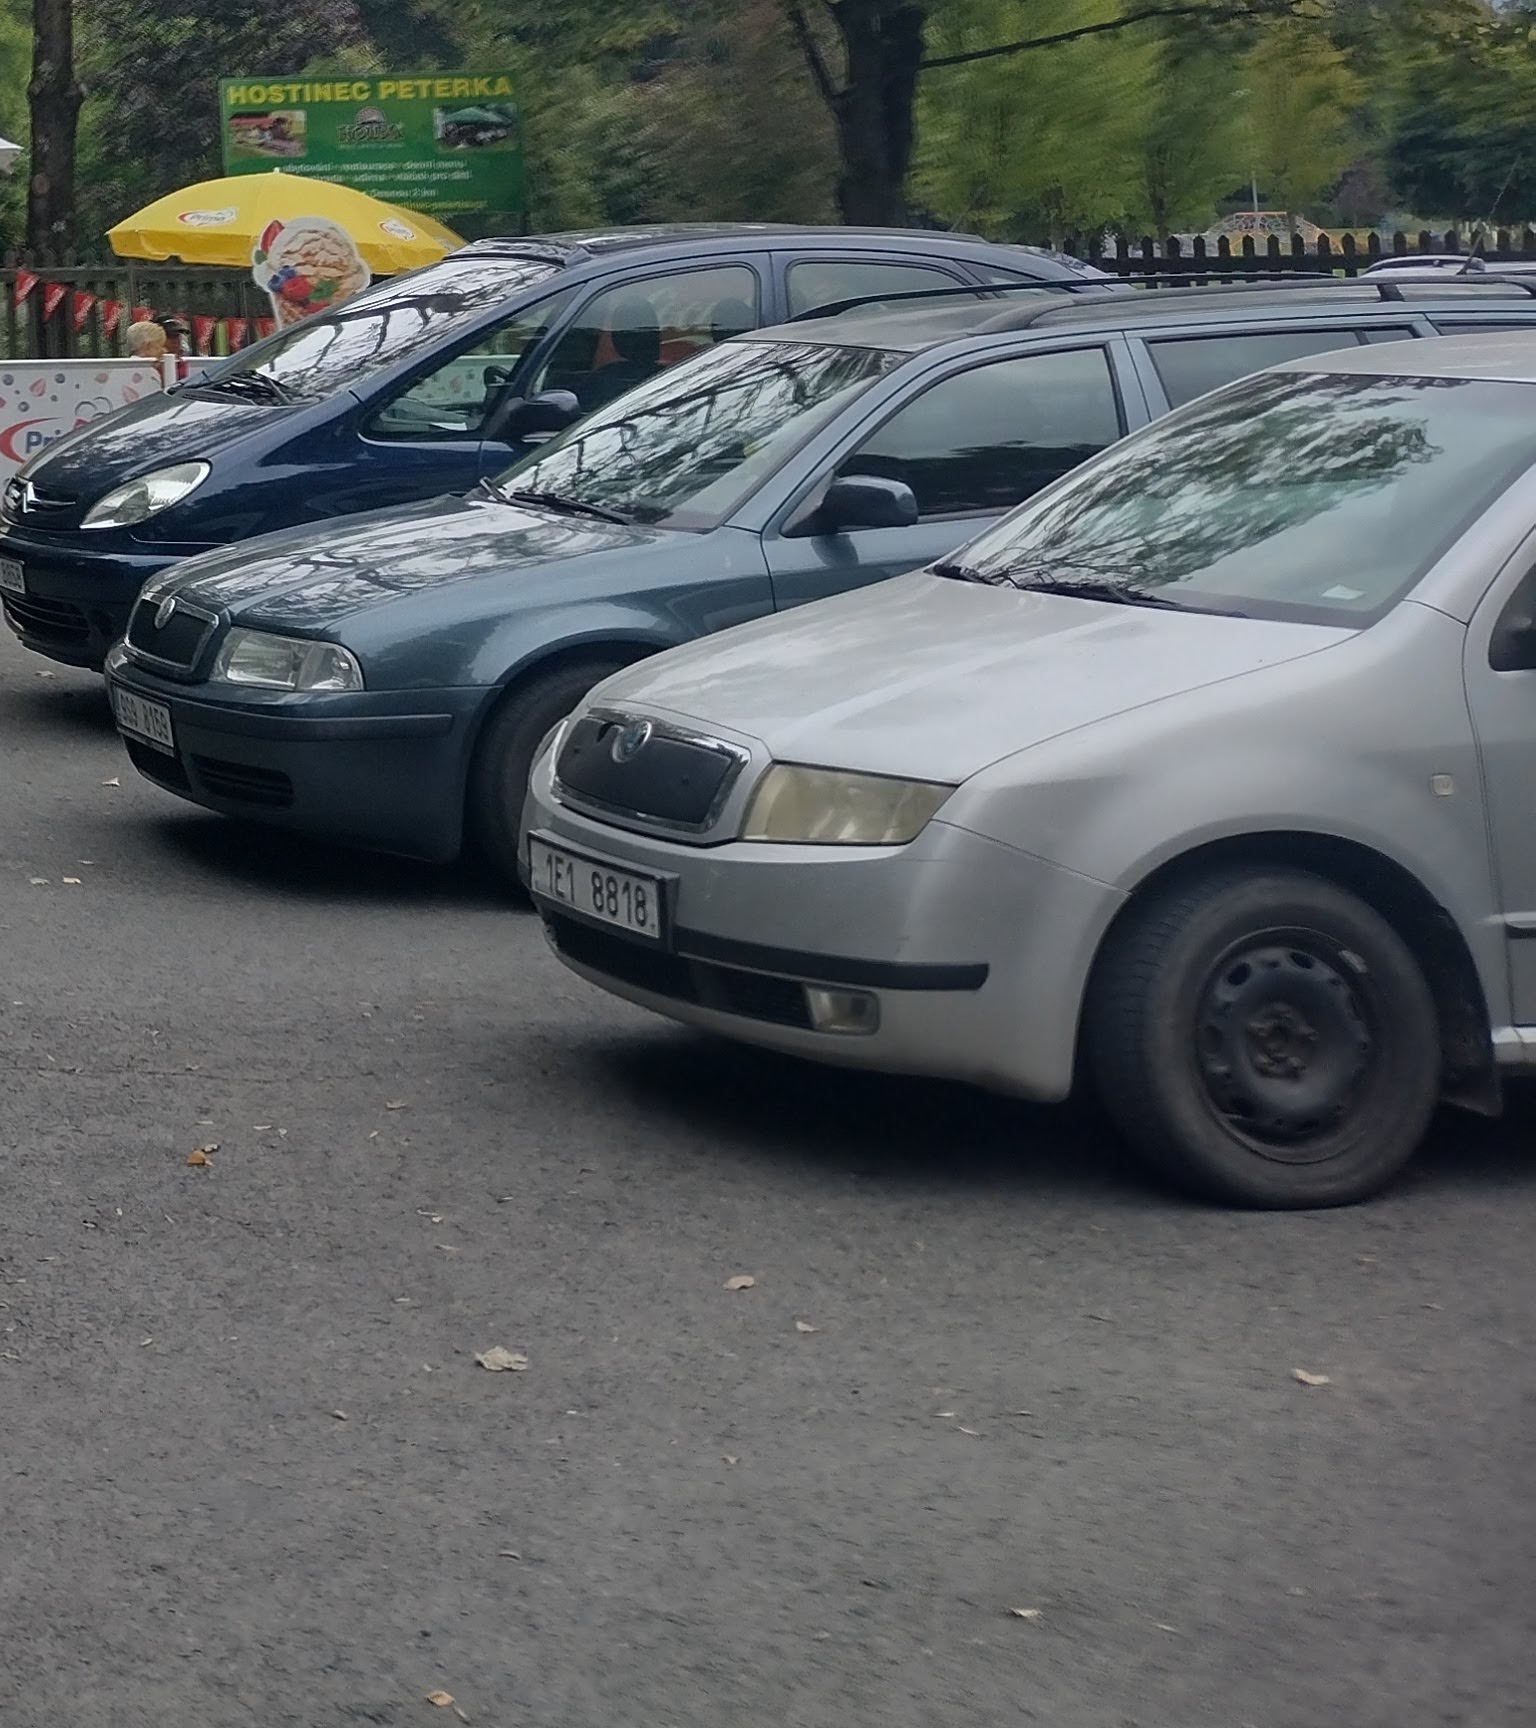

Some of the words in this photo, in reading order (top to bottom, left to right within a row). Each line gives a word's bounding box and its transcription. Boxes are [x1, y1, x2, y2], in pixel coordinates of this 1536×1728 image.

[228, 81, 370, 105] HOSTINEC
[379, 76, 512, 99] PETERKA
[546, 853, 575, 902] 1E1
[591, 871, 647, 927] 8818
